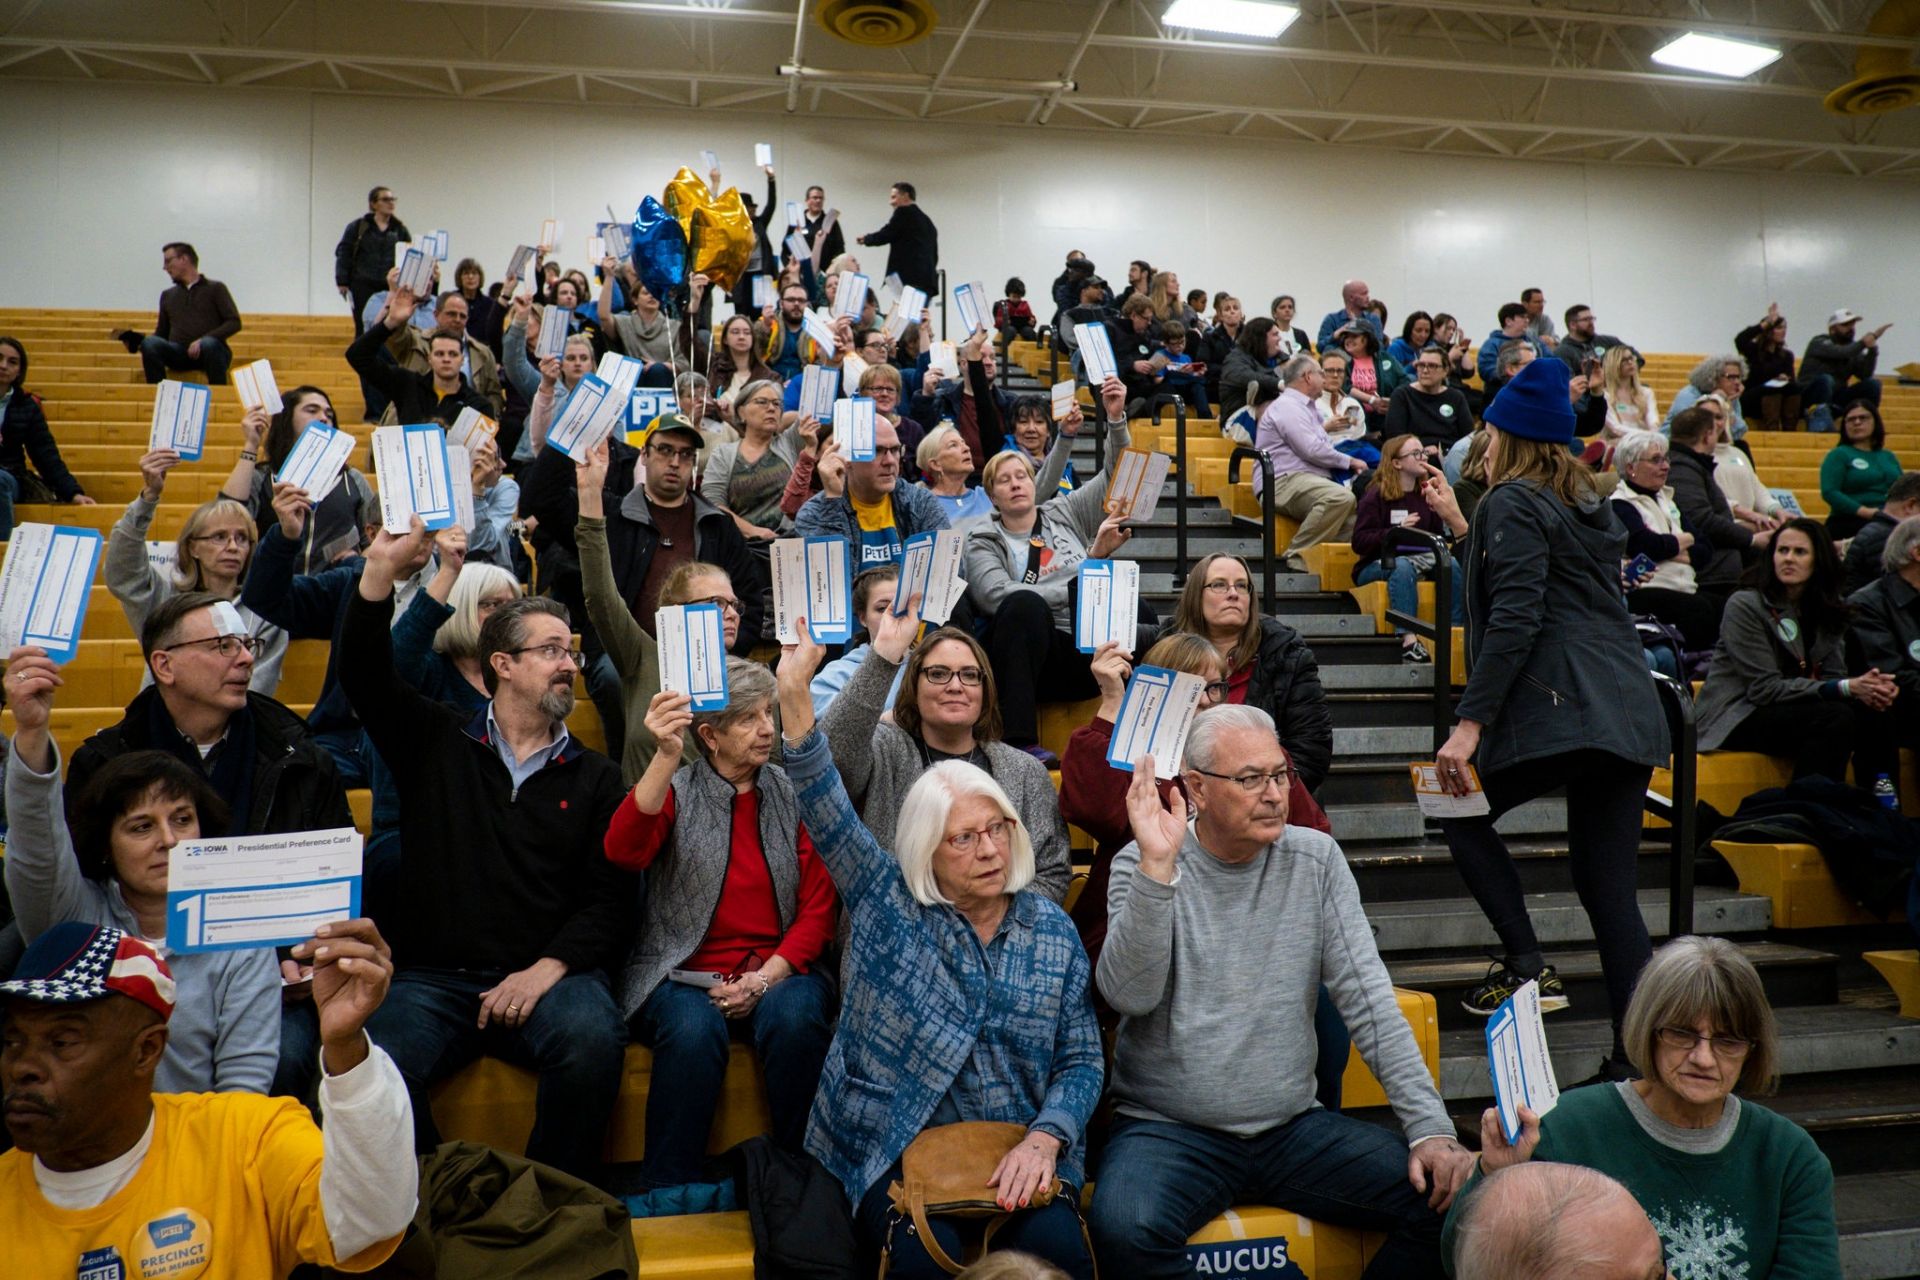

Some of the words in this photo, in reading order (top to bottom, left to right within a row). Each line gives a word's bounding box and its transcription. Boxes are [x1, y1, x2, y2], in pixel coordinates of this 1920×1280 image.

[583, 378, 606, 397] 1
[632, 396, 677, 425] PE
[907, 535, 933, 550] 1
[7, 545, 20, 577] Preference
[16, 531, 24, 545] Card
[864, 546, 889, 559] PETE
[1063, 552, 1085, 566] PETE
[1083, 564, 1111, 576] 1
[811, 624, 847, 639] 1
[1137, 673, 1170, 686] 1
[692, 693, 724, 707] 1
[1190, 691, 1198, 703] IOWA
[1179, 707, 1191, 734] Presidential
[1171, 733, 1182, 759] Preference
[1168, 760, 1177, 773] Card
[1413, 766, 1429, 792] 2
[204, 845, 229, 853] IOWA
[237, 841, 287, 852] Presidential
[289, 837, 332, 848] Preference
[333, 835, 352, 844] Card
[176, 893, 201, 947] 1
[1490, 1007, 1514, 1040] 1
[1548, 1084, 1556, 1099] Card
[141, 1244, 204, 1269] PRECINCT
[1187, 1245, 1287, 1274] AUCUS
[81, 1266, 118, 1280] PETE
[144, 1266, 167, 1278] TEAM
[169, 1257, 206, 1271] MEMBER
